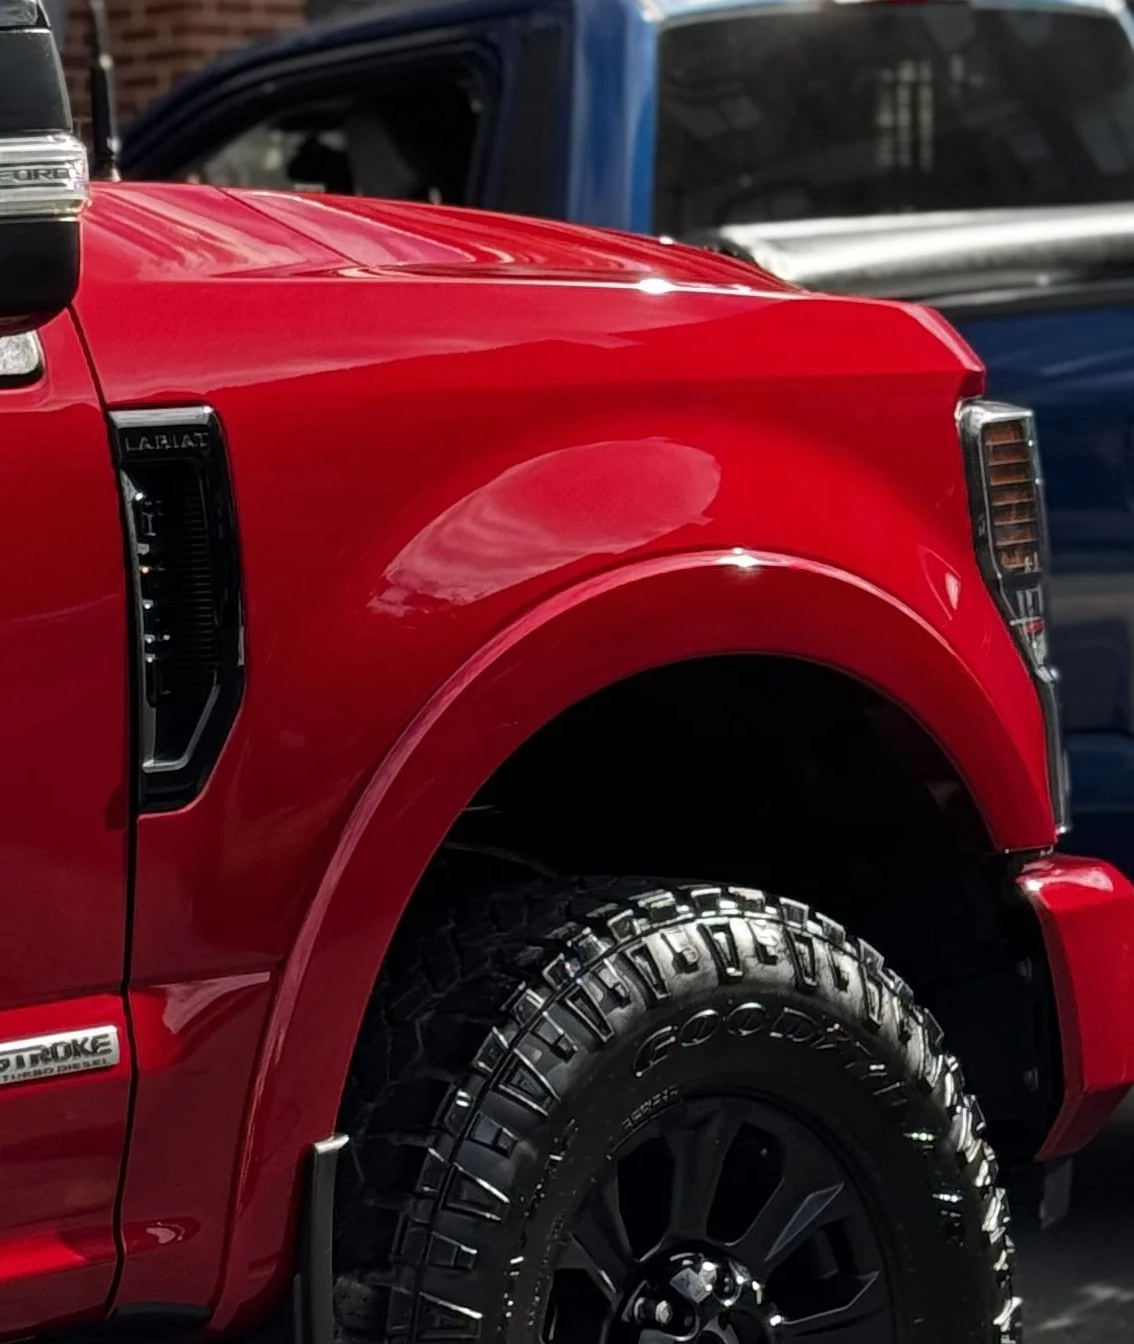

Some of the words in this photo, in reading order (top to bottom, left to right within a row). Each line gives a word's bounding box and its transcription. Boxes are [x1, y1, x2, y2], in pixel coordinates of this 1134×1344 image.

[124, 432, 209, 452] LARIAT
[3, 1067, 54, 1082] TURBO
[57, 1058, 108, 1074] DIESEL
